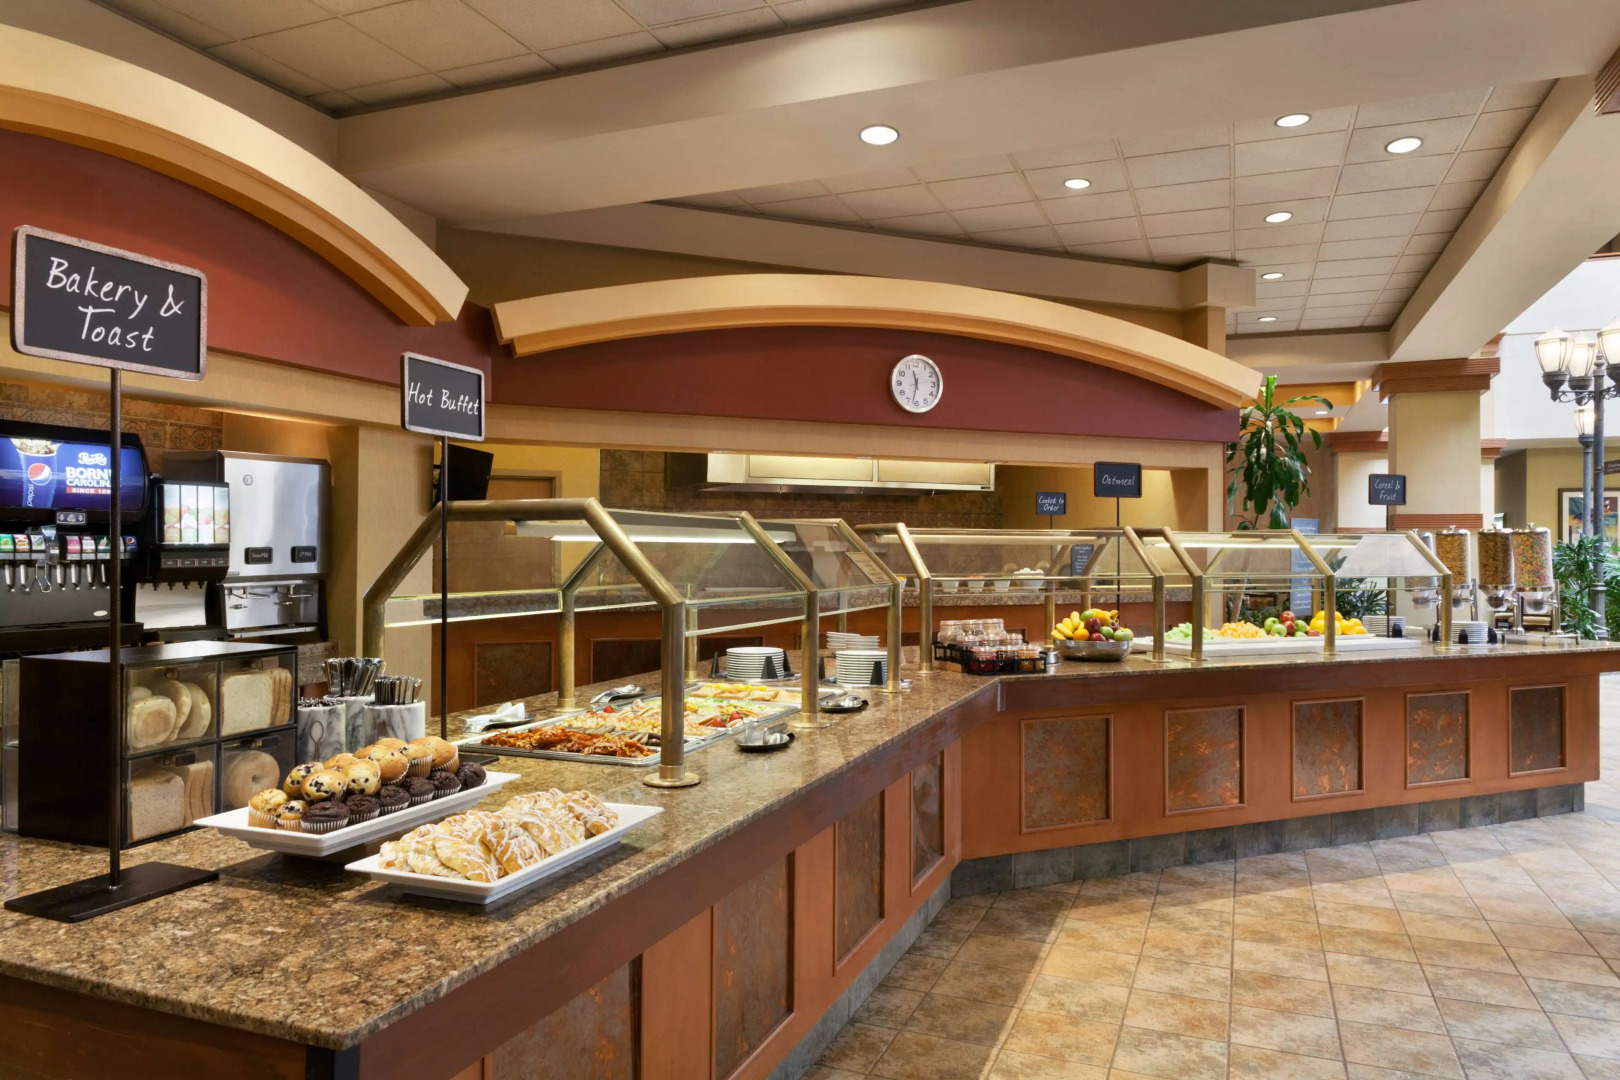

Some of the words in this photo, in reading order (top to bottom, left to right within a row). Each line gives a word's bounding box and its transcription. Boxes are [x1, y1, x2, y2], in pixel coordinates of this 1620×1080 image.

[46, 256, 148, 320] Bakery
[159, 284, 185, 317] &
[77, 305, 154, 352] Toast
[408, 382, 434, 406] Hot
[440, 388, 480, 415] Buffet
[66, 466, 107, 480] BORN
[1101, 474, 1136, 486] Oatmeal
[1374, 479, 1393, 489] Cereal
[1394, 480, 1401, 490] &
[72, 487, 95, 495] SINCE
[1379, 490, 1397, 500] Fruit
[1038, 495, 1057, 504] Cooked
[1043, 503, 1059, 511] Order
